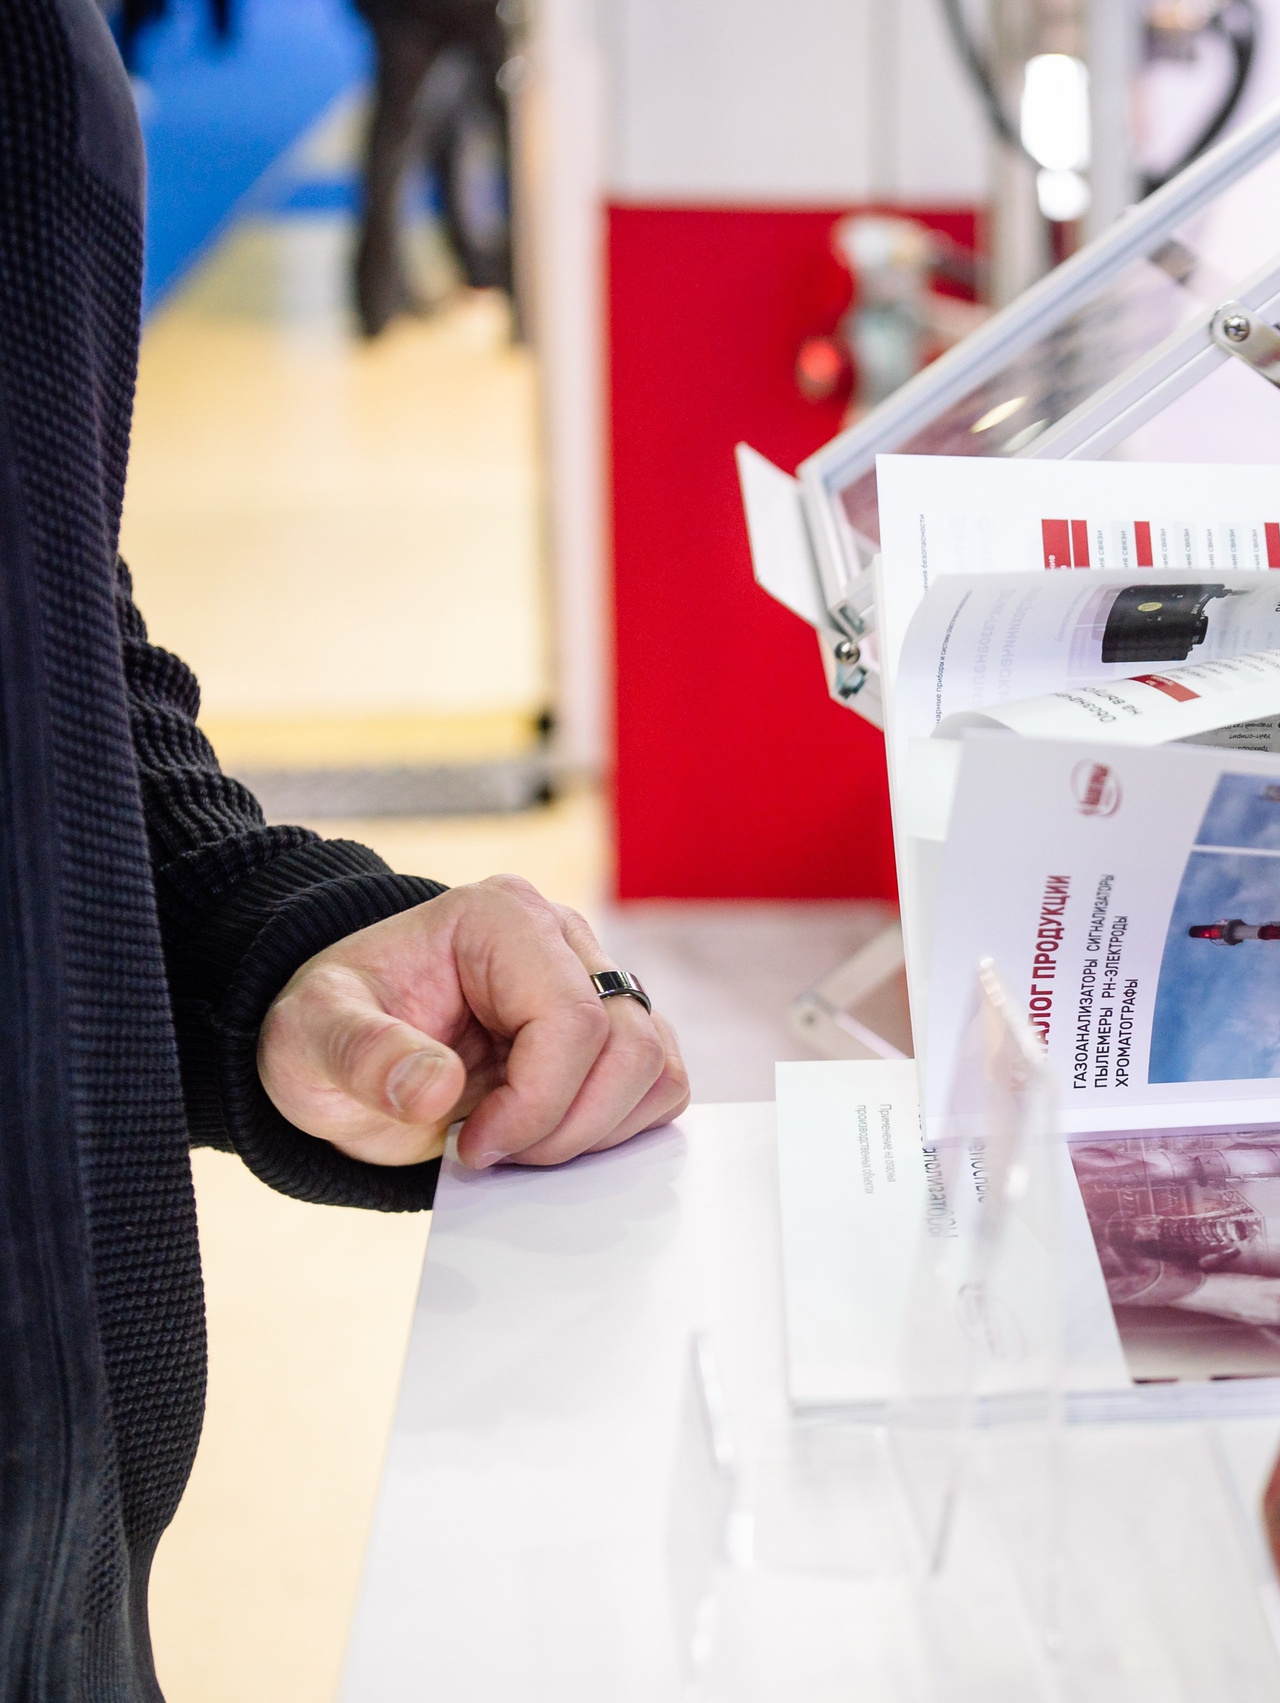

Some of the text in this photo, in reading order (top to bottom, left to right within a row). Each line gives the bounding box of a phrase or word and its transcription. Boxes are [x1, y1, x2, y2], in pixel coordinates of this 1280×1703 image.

[1031, 875, 1071, 980] ПРОДУКЦИИ
[1073, 874, 1115, 1090] ГАЗОАНАЛИЗАТОРЫ СИГНАЛИЗАТОРЫ
[1093, 1007, 1114, 1089] ПЫЛЕМЕРЫ
[1114, 979, 1139, 1088] ХРОМАТОГРАФЫ
[855, 1104, 876, 1195] производственных объектах
[877, 1103, 893, 1150] Применение
[884, 1151, 894, 1159] на
